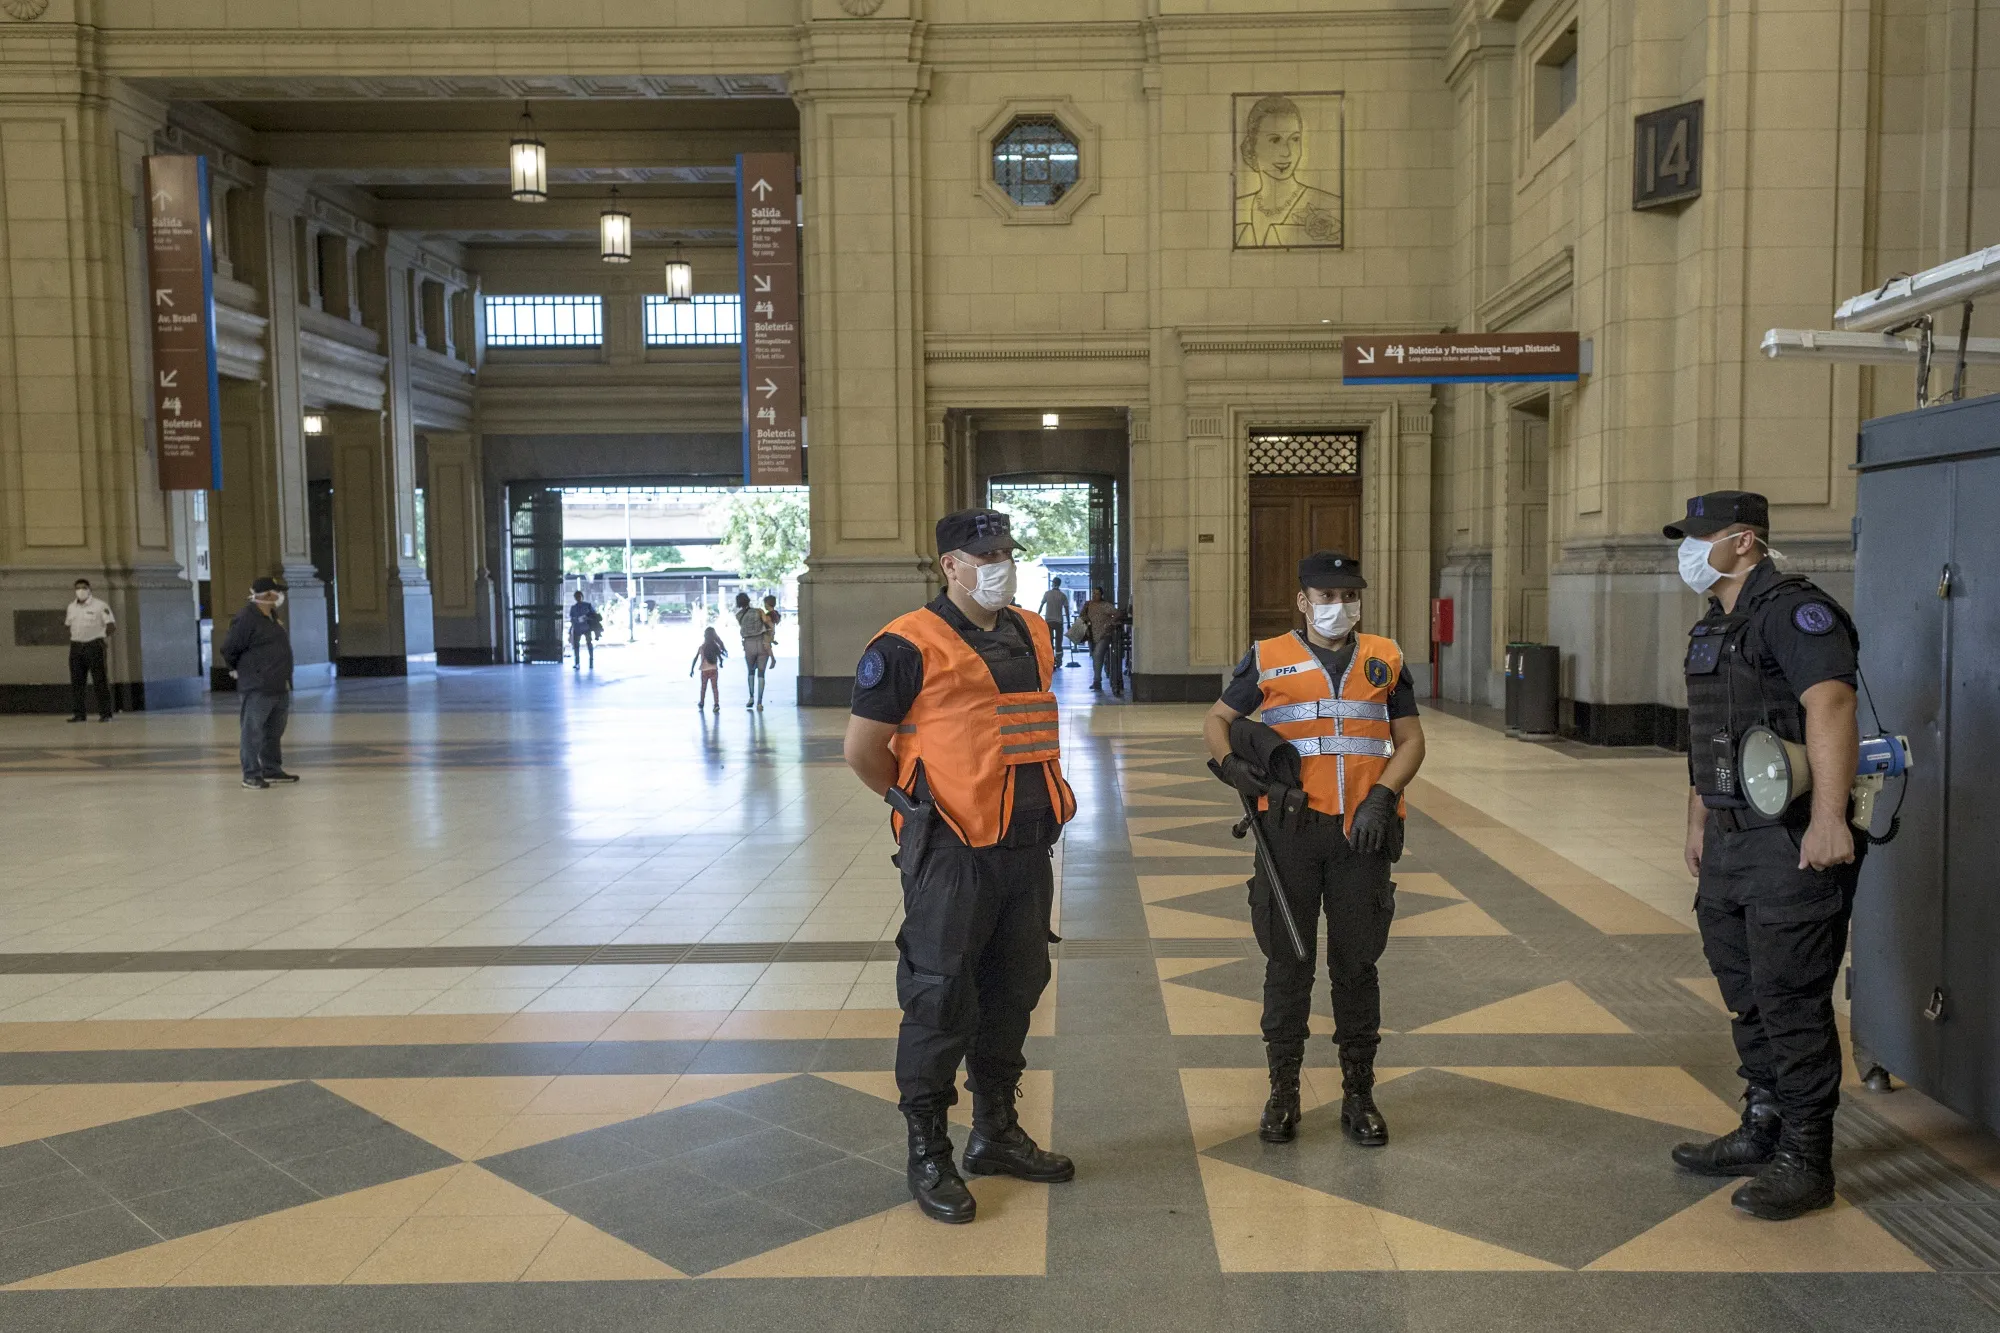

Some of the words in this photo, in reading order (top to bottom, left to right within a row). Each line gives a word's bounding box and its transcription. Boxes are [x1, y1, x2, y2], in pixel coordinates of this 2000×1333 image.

[1645, 118, 1690, 193] 14
[752, 208, 781, 218] Salida
[152, 216, 183, 228] Salida
[158, 313, 171, 324] Av.
[172, 313, 198, 324] Brasil
[755, 322, 794, 331] Boletería
[1409, 346, 1443, 354] Boletería
[1443, 347, 1450, 356] y
[1451, 345, 1501, 355] Preembarque
[1502, 345, 1524, 356] Larga
[1525, 343, 1561, 353] Distancia
[163, 418, 203, 429] Boletería
[757, 428, 796, 438] Boletería
[1275, 666, 1297, 676] PFA
